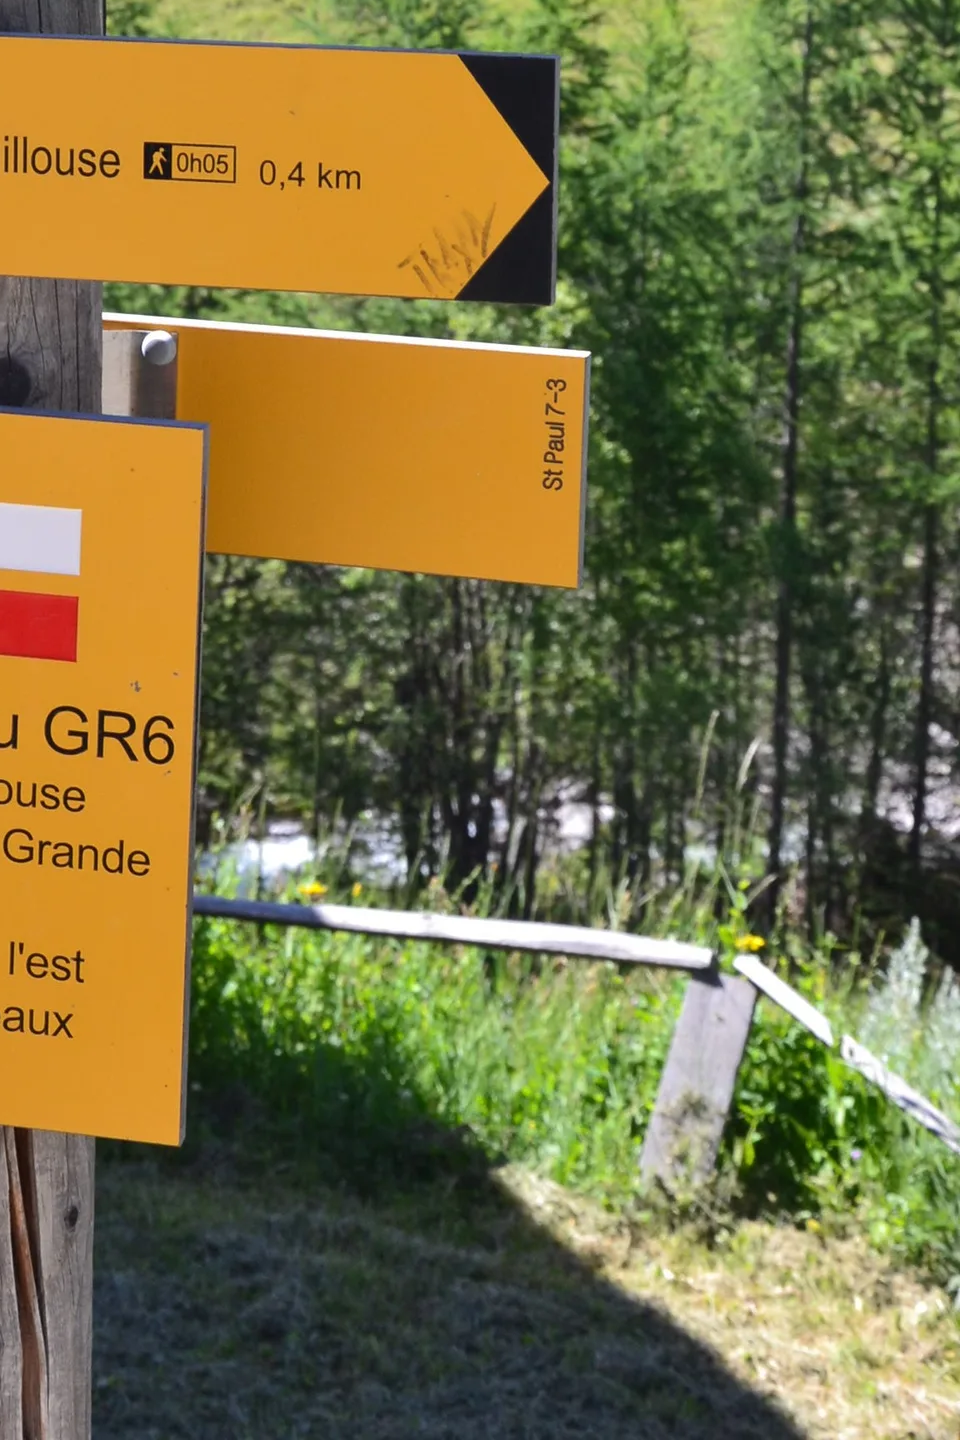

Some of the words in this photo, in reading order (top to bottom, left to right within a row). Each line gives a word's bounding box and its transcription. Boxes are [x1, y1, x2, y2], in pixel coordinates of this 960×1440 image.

[176, 152, 229, 175] 0h05
[259, 159, 306, 191] 0,4
[318, 162, 361, 190] km
[544, 378, 567, 416] 7-3
[543, 421, 565, 465] Paul
[542, 468, 564, 491] St
[44, 705, 175, 765] GR6
[2, 828, 151, 877] Grande
[9, 941, 85, 984] l'est
